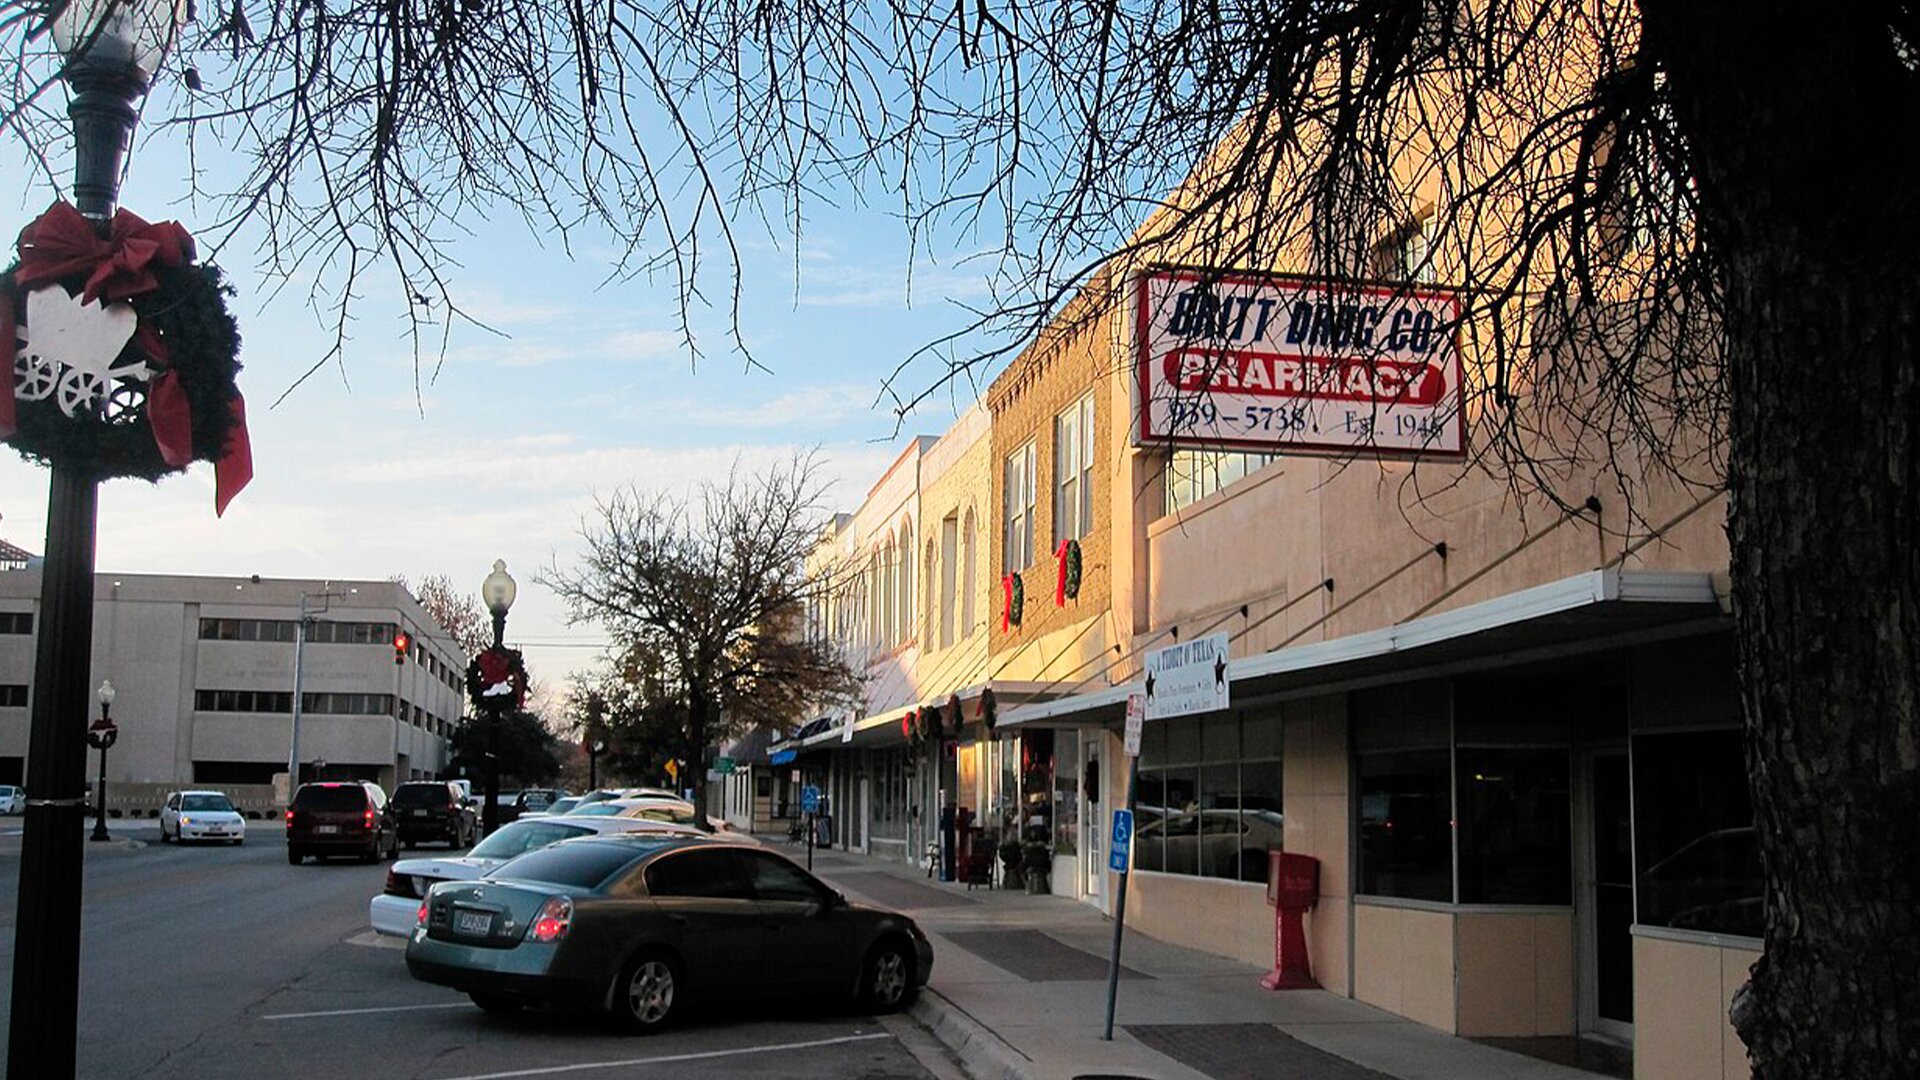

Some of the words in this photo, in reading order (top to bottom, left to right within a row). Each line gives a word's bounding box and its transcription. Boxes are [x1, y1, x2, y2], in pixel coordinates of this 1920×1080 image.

[1169, 292, 1276, 341] BRITT
[1286, 301, 1377, 349] DRUG
[1180, 353, 1428, 398] PHARMACY
[1345, 410, 1383, 436] Es.
[1193, 638, 1215, 664] TEXAS
